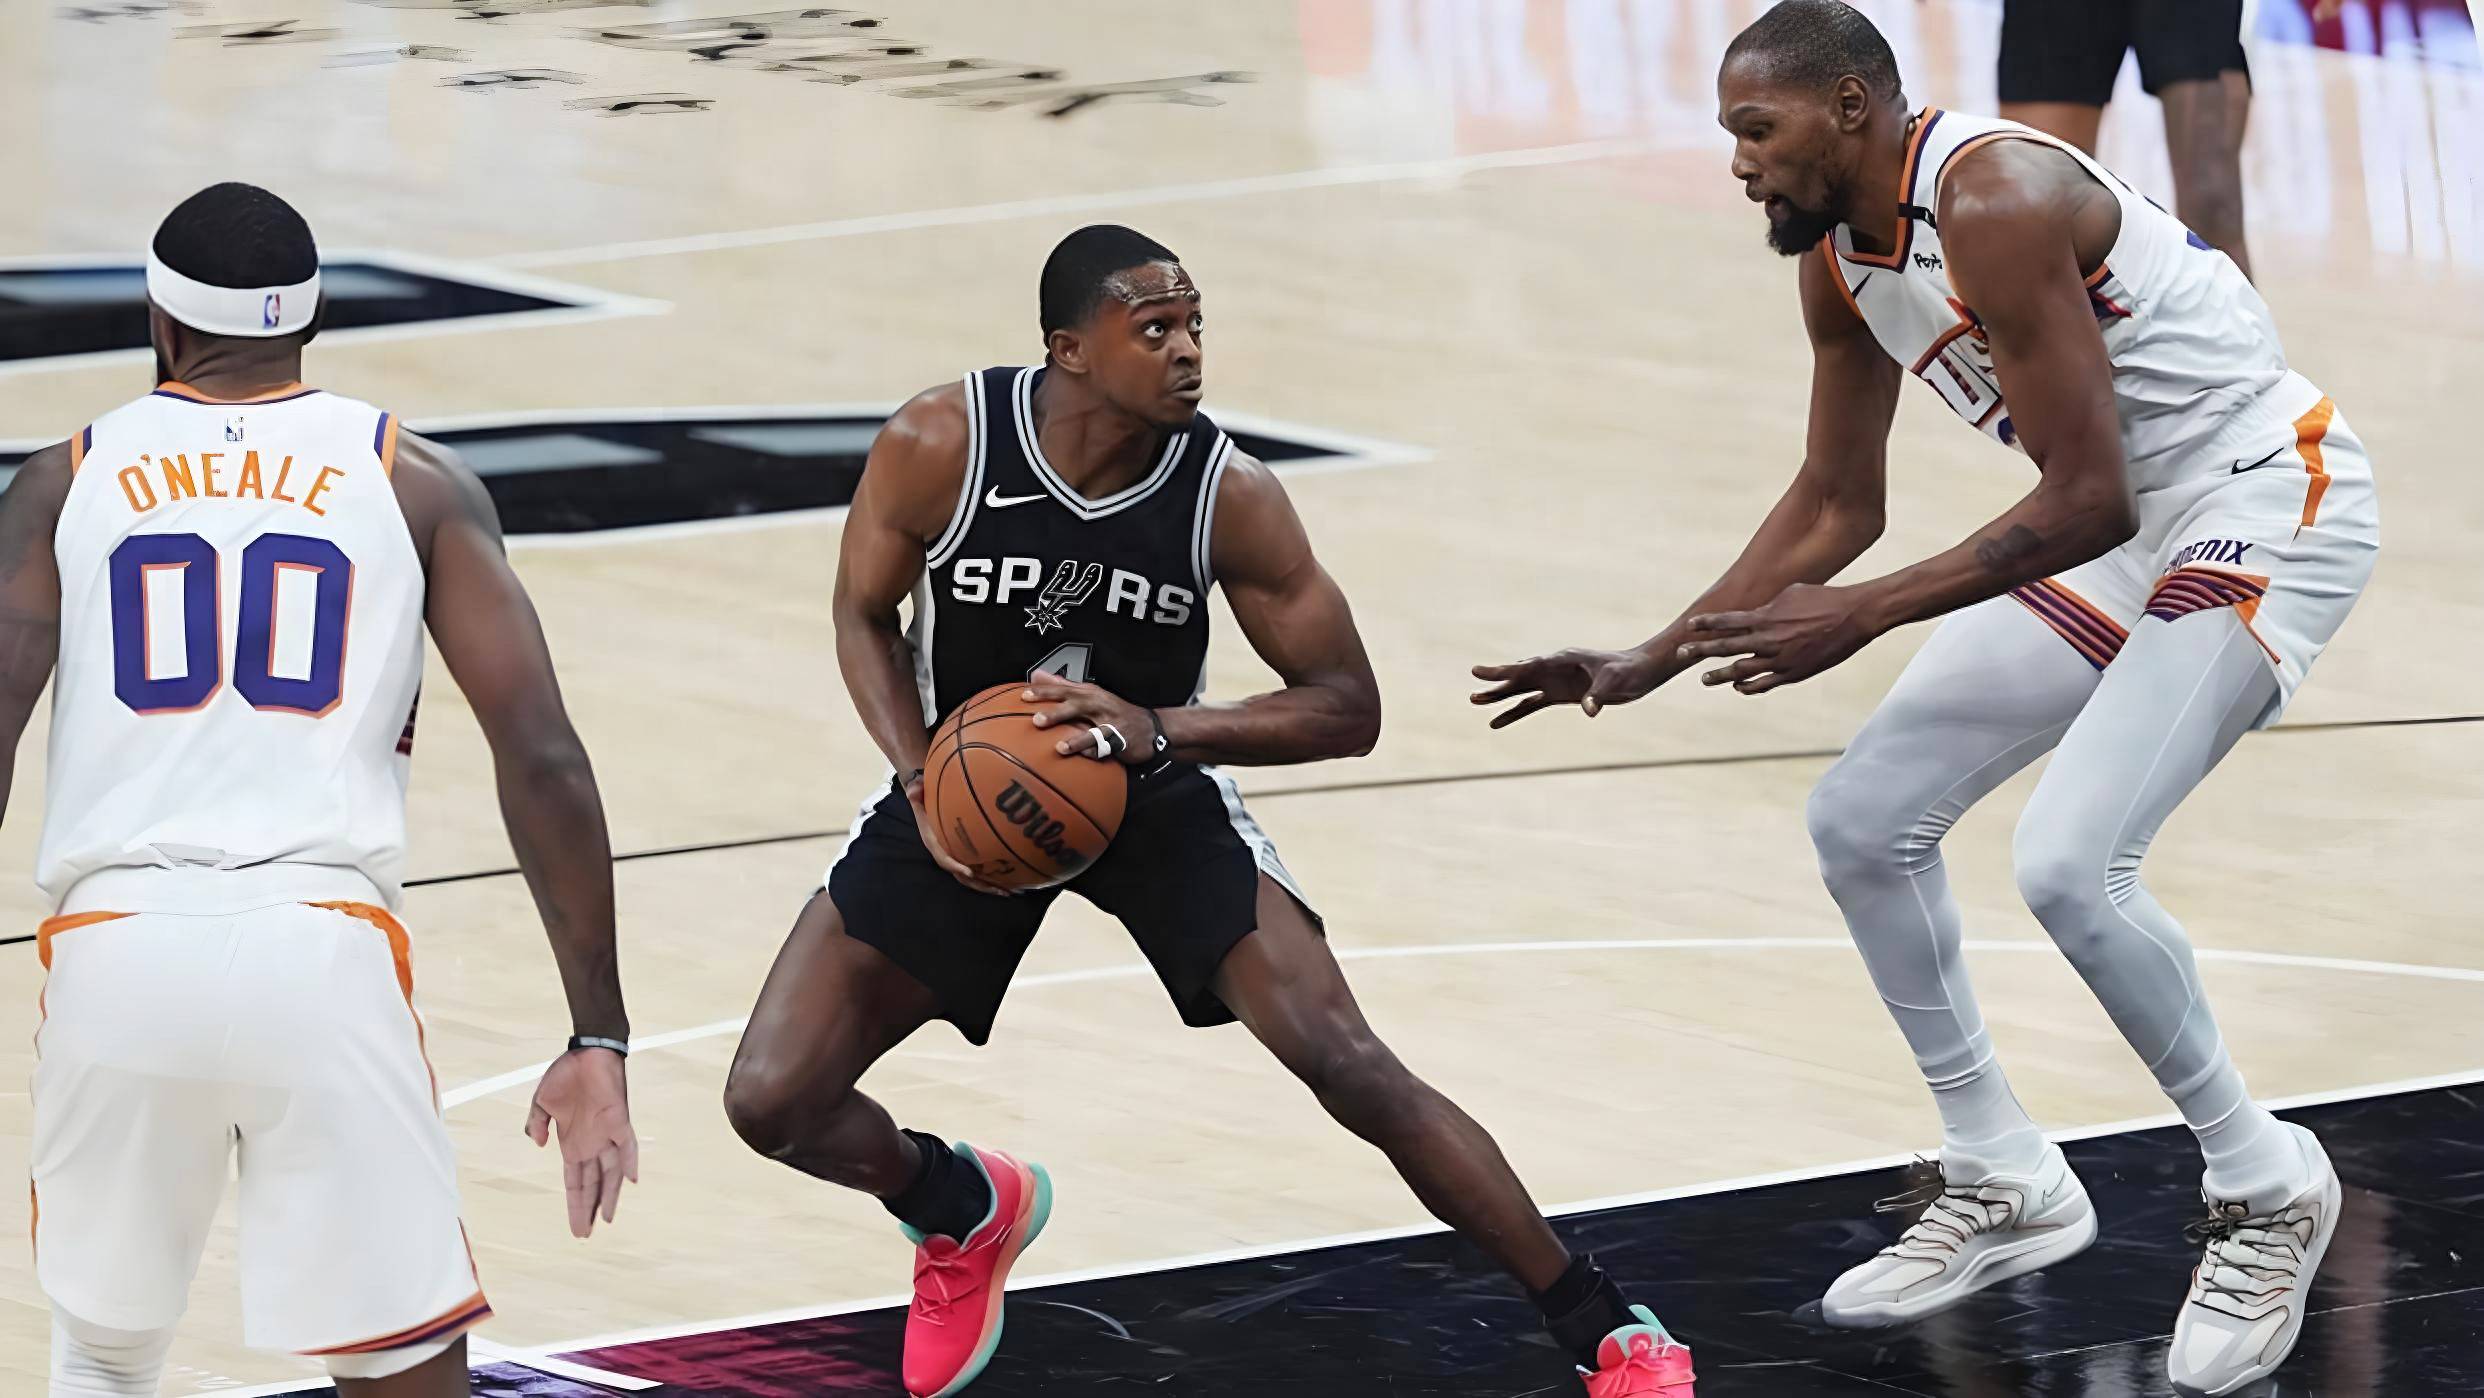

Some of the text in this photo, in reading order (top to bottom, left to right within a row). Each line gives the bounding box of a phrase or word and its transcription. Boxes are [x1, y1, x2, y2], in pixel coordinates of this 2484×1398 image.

[118, 450, 346, 517] O'NEALE
[108, 532, 356, 720] 00
[952, 556, 1195, 634] SPURS
